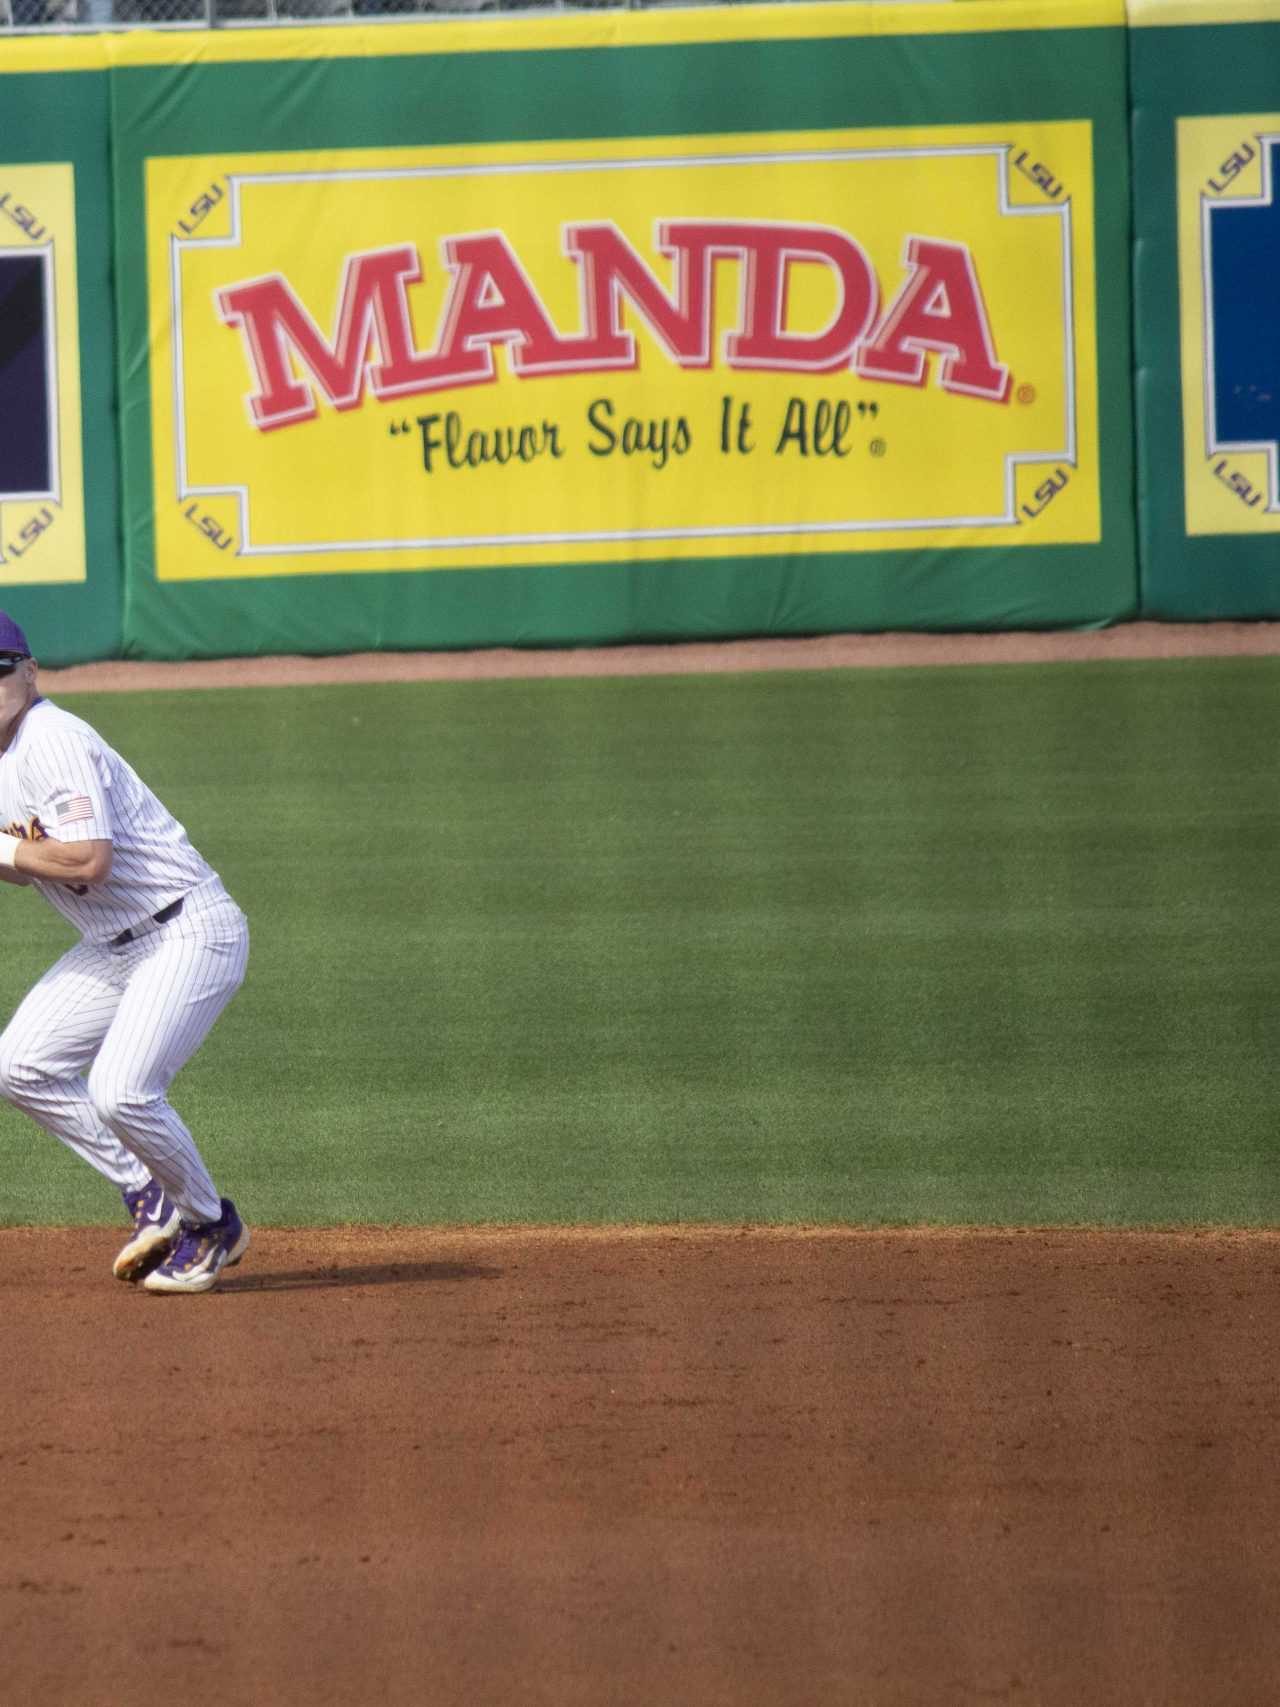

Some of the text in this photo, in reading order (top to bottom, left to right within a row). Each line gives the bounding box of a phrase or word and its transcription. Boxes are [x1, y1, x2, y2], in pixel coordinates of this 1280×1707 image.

[1013, 151, 1064, 199] LSU
[1207, 143, 1256, 194] LSU
[178, 184, 223, 235] LSU
[215, 218, 1013, 433] MANDA
[588, 398, 692, 468] Says
[720, 395, 755, 454] It
[1022, 469, 1069, 518] LSU
[1213, 460, 1263, 507] LSU
[7, 507, 53, 558] LSU
[184, 503, 232, 550] LSU
